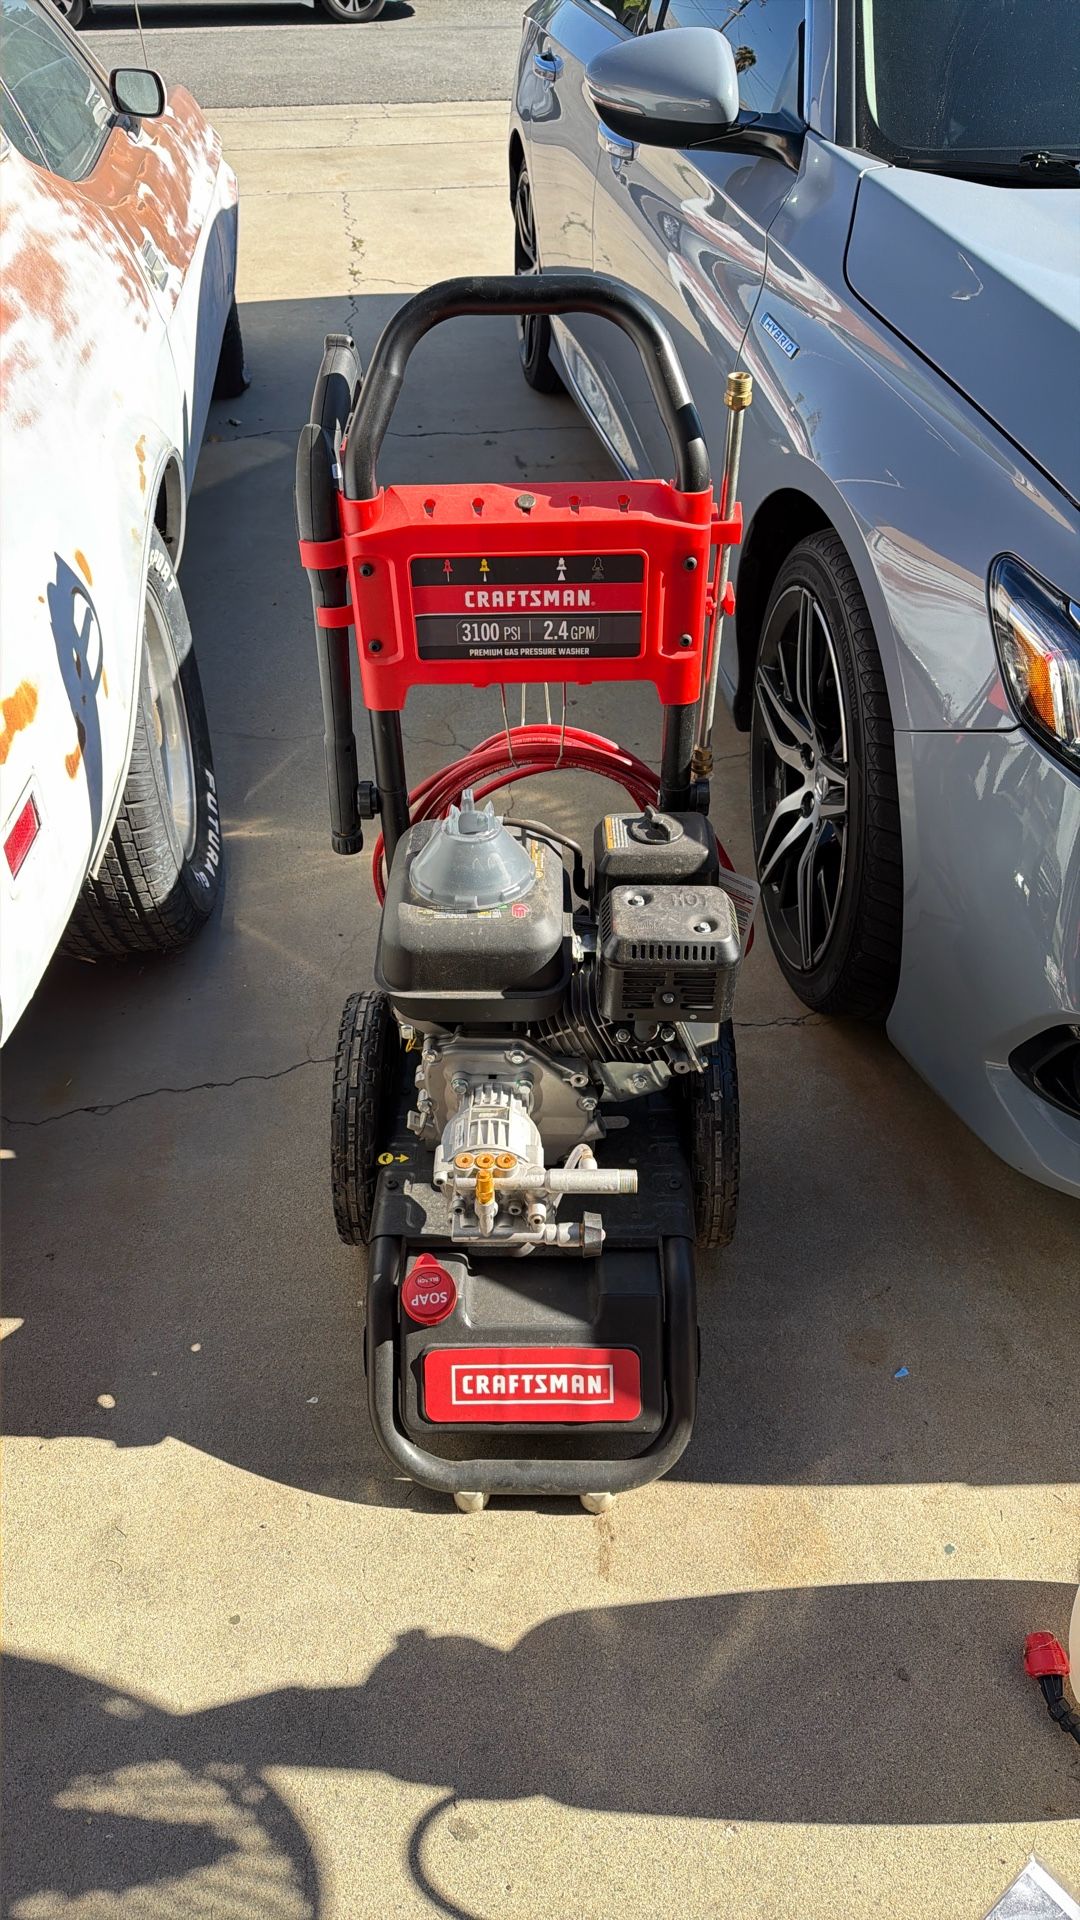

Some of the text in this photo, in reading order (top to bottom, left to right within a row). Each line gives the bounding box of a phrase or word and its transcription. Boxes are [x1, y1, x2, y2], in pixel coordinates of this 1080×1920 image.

[764, 319, 795, 353] HYBRID
[464, 589, 591, 608] CRAFTSMAN
[461, 622, 521, 642] 3100 PSI
[543, 620, 595, 641] 2.4 GPM
[469, 647, 590, 657] PREMIUM GAS PRESSURE WASHER
[204, 768, 221, 878] FUTURA
[411, 1291, 448, 1306] SOAP
[462, 1374, 603, 1395] CRAFTSMAN
